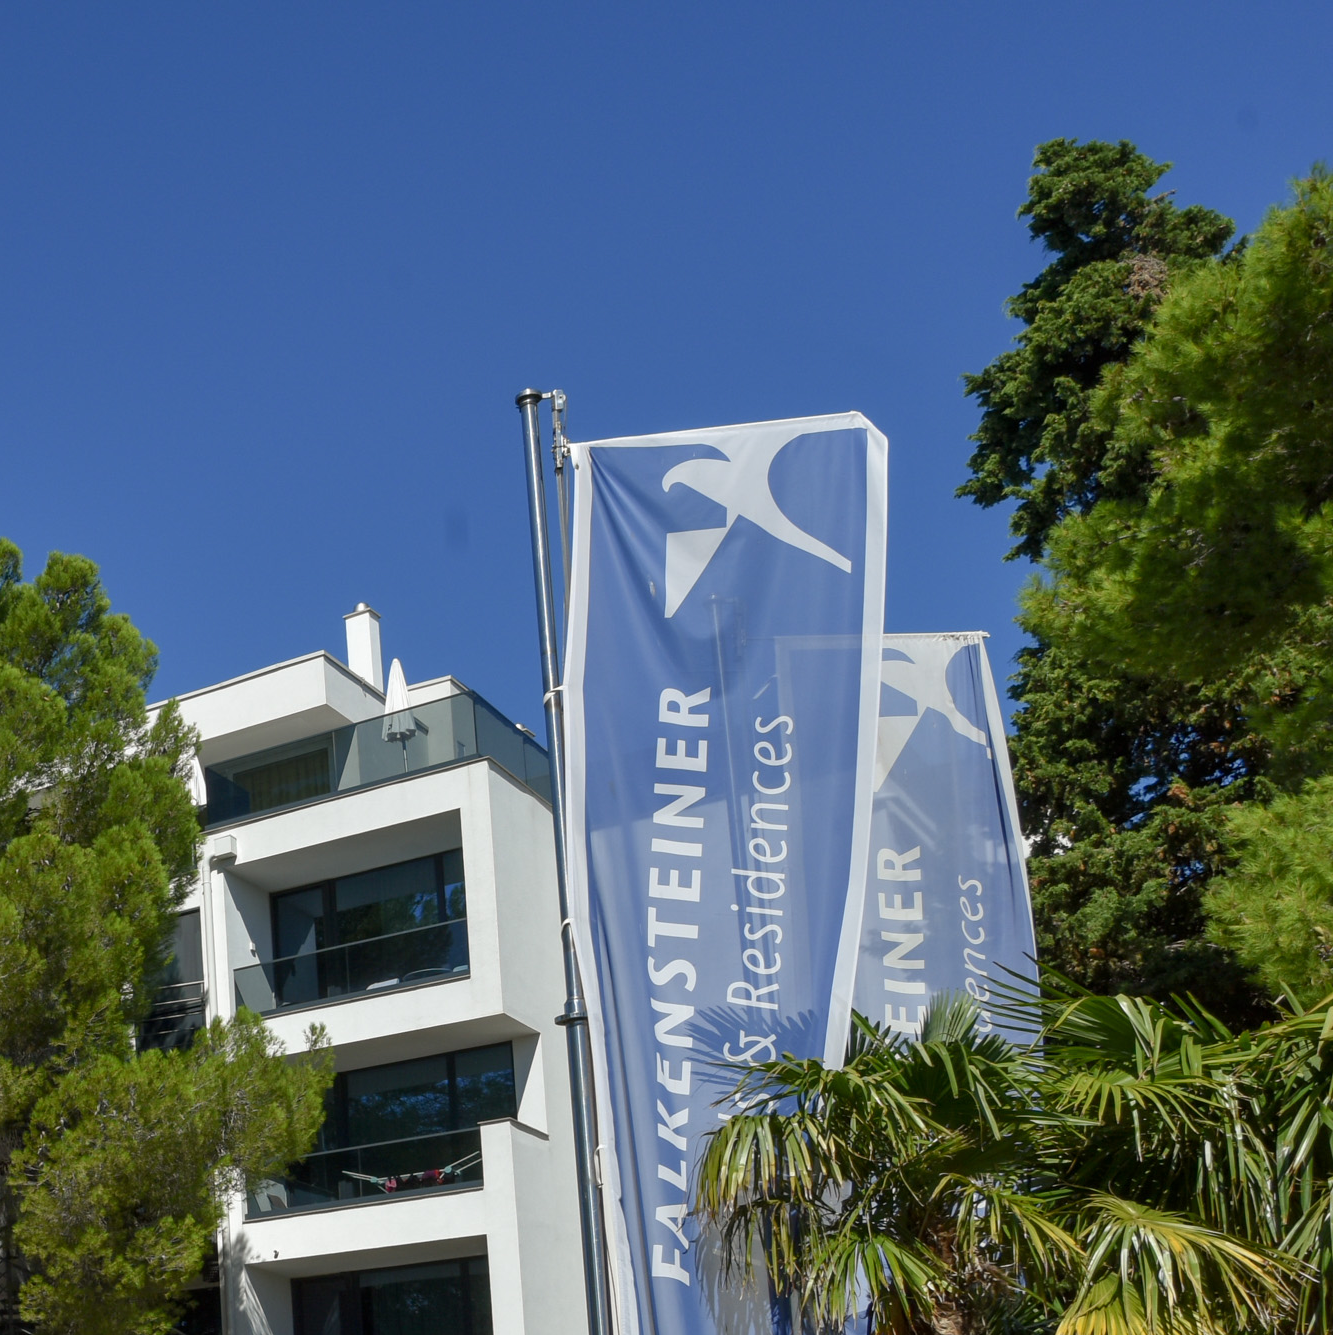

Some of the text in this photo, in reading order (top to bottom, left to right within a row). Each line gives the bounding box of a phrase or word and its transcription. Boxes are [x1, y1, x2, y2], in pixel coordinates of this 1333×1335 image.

[726, 715, 794, 1011] Residences
[877, 846, 926, 1036] EINER
[647, 687, 712, 1286] FALKENSTEINER
[723, 1029, 777, 1068] &
